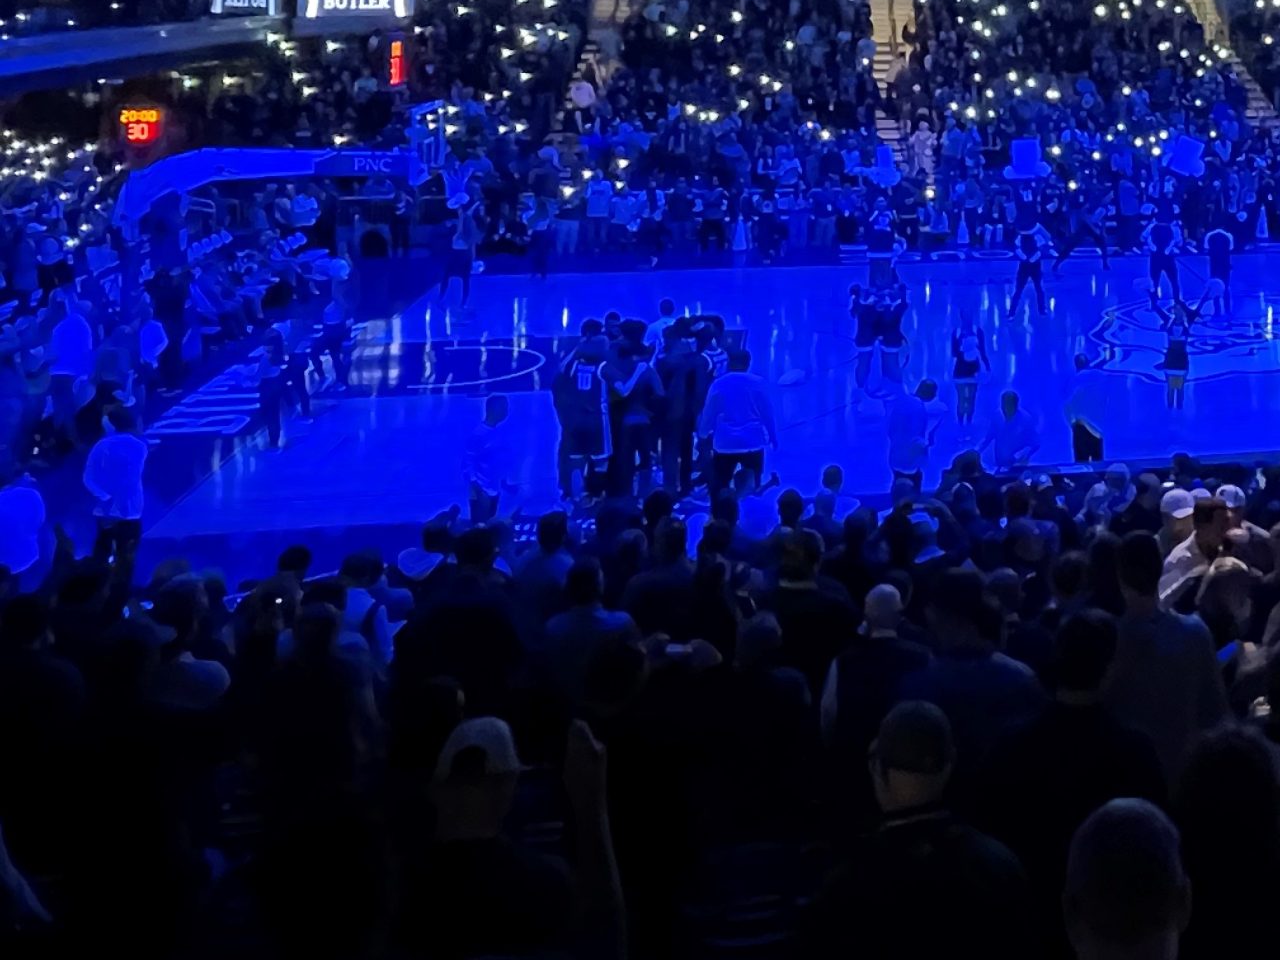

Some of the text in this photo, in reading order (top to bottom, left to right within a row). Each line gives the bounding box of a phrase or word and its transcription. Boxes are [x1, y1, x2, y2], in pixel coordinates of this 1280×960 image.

[120, 109, 157, 123] 20:00
[128, 123, 149, 140] 30
[354, 157, 392, 172] PNC
